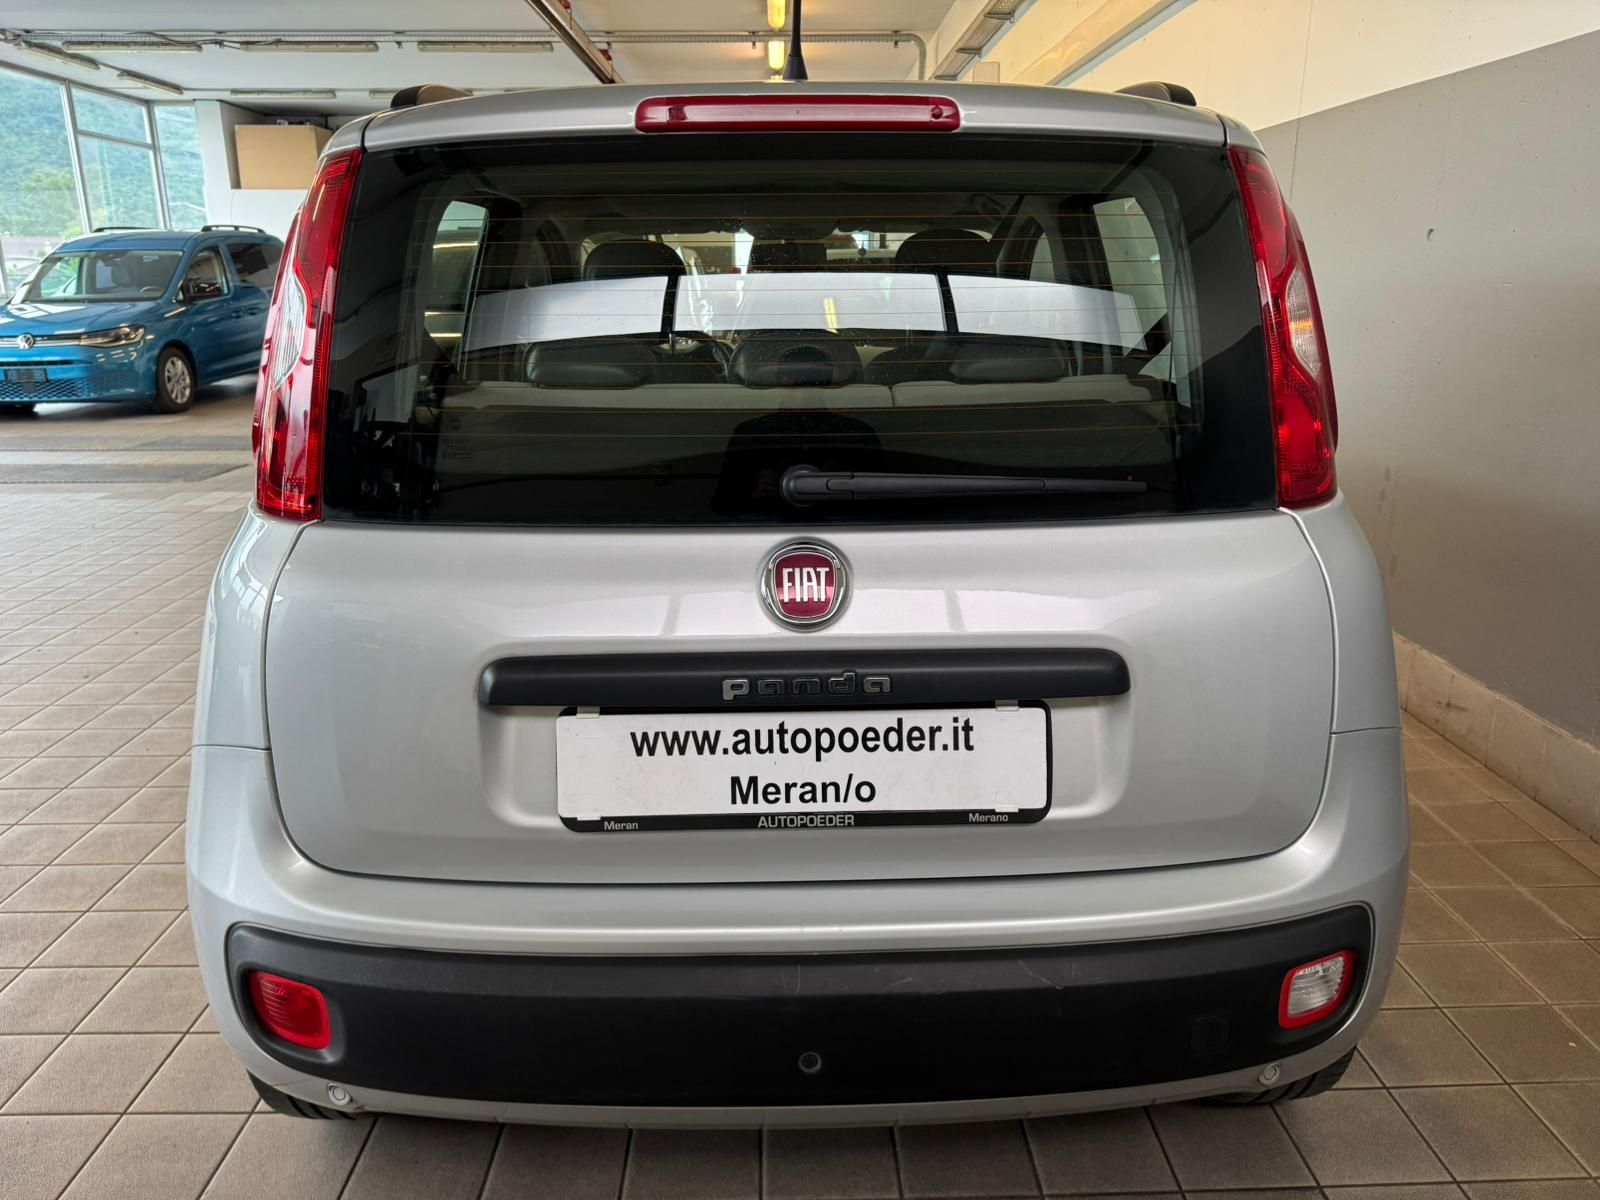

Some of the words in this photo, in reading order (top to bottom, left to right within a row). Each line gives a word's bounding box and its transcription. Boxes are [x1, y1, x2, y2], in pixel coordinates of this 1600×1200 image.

[782, 567, 830, 603] FIAT
[722, 671, 891, 701] panda
[630, 717, 975, 762] www.autopoeder.it
[730, 774, 877, 805] Meran/o
[604, 821, 639, 831] Meran
[758, 814, 855, 828] AUTOPOEDER
[968, 813, 1009, 823] Merano
